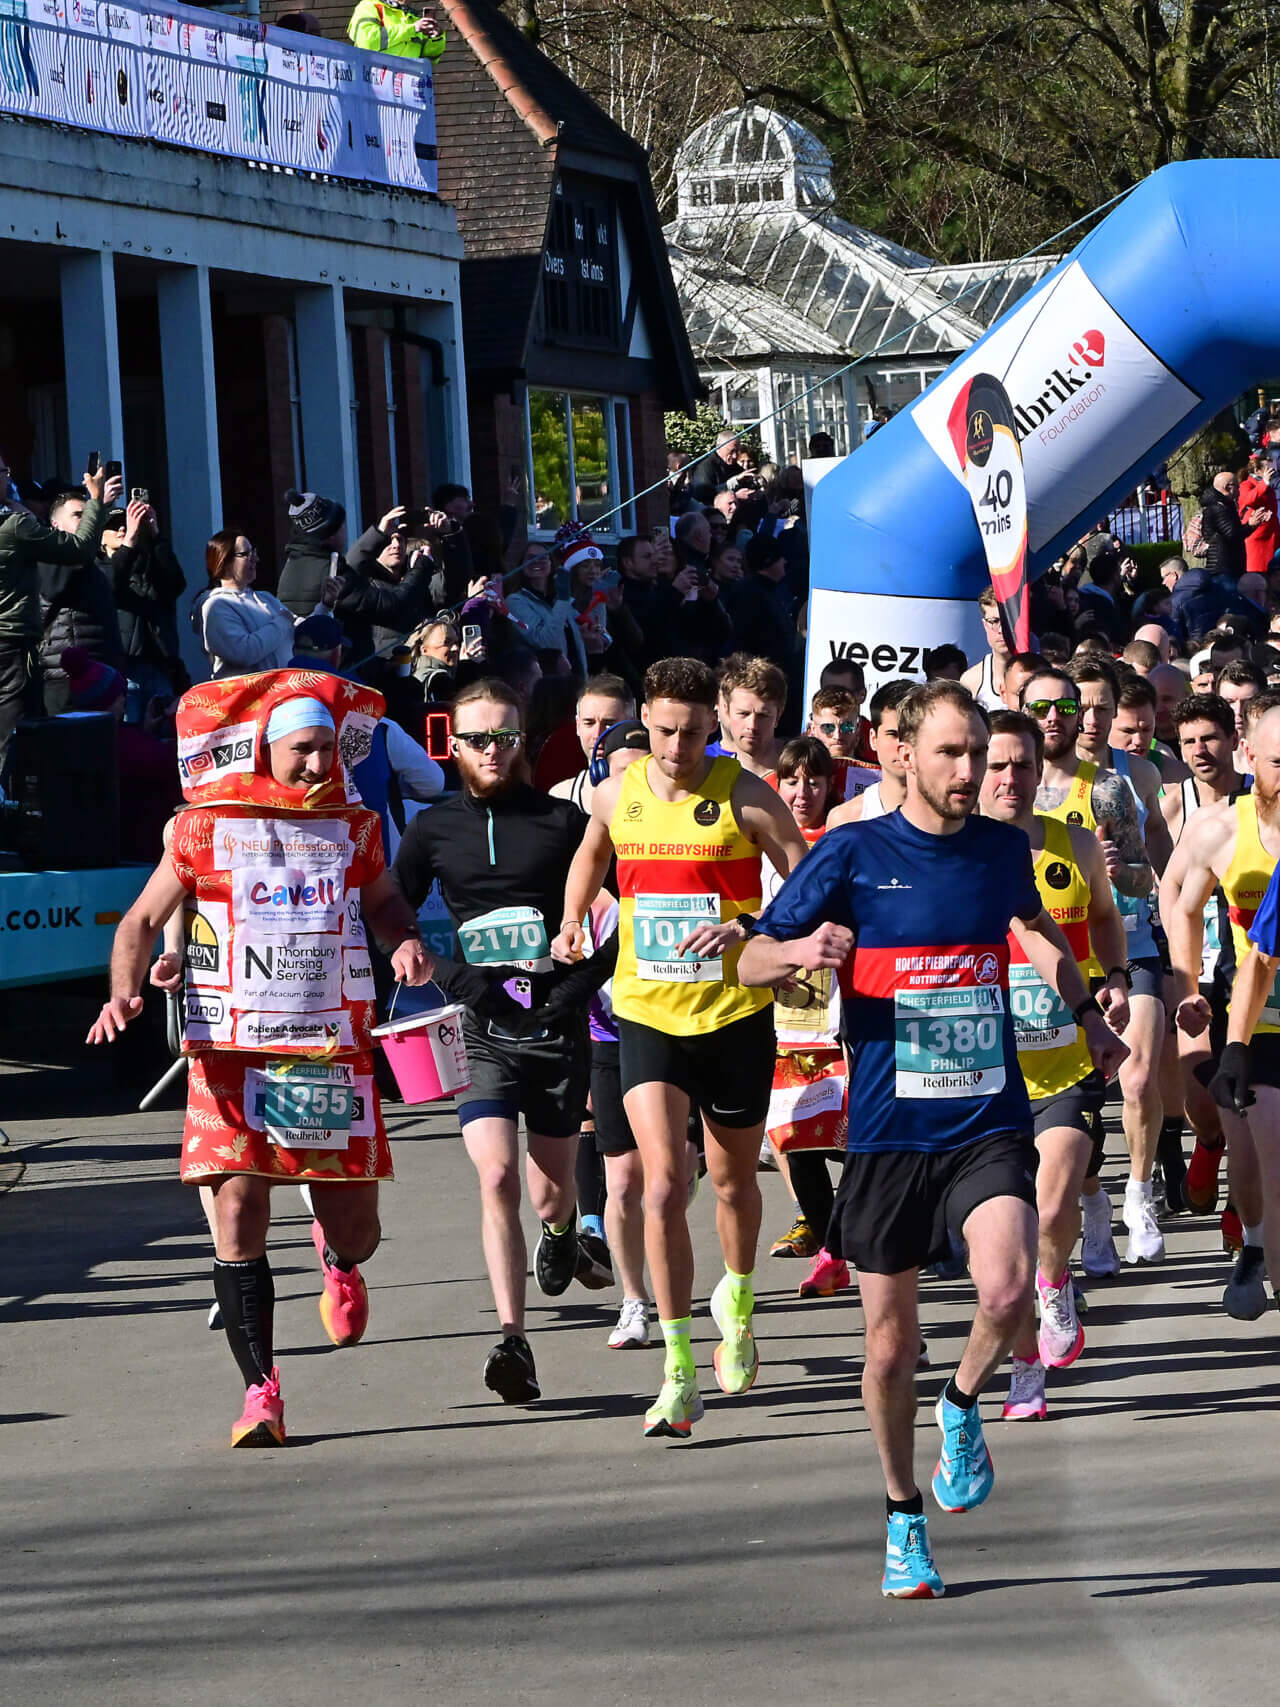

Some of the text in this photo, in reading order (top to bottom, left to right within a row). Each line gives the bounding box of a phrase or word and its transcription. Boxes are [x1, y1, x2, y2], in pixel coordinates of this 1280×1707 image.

[545, 250, 564, 275] Overs
[1015, 367, 1092, 442] dbrik.
[1039, 383, 1107, 447] Foundation
[979, 469, 1013, 513] 40
[981, 514, 1011, 536] mins
[829, 640, 932, 674] veez
[241, 839, 349, 852] NEU Professionals
[649, 843, 734, 857] DERBYSHIRE
[464, 923, 542, 952] 2170
[277, 946, 336, 960] Thornbury
[277, 959, 323, 971] Nursing
[895, 954, 976, 972] HOLME PIERREPONT
[276, 970, 328, 981] Services
[909, 973, 961, 985] NOTTINGHAM
[244, 989, 325, 998] Part of Acacium Group
[901, 988, 999, 1008] CHESTERFIELD 10K
[248, 1024, 323, 1033] Patient Advocate
[905, 1017, 998, 1056] 1380
[1016, 1031, 1051, 1043] edbrik.
[930, 1057, 975, 1071] PHILIP
[274, 1085, 349, 1113] 1955
[295, 1117, 323, 1127] JOAN
